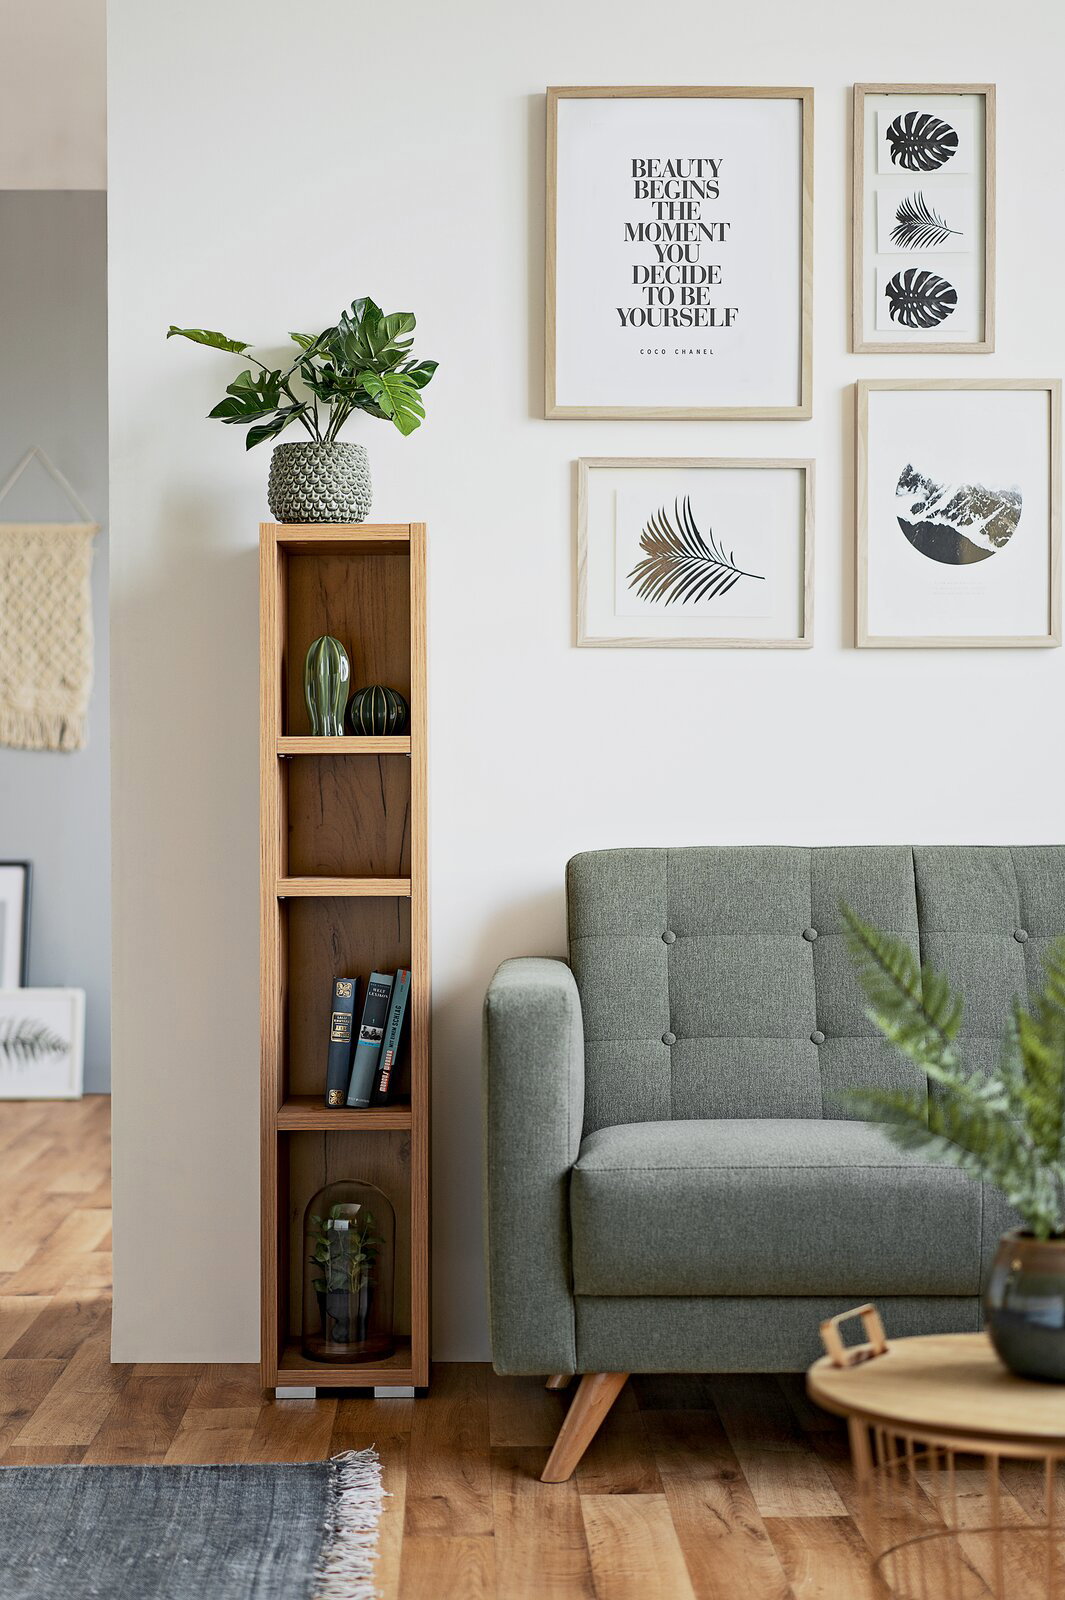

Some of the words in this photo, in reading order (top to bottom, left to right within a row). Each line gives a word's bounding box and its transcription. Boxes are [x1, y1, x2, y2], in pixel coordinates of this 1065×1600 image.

[631, 158, 723, 179] BEAUTY
[634, 179, 720, 200] BEGINS
[651, 201, 702, 221] THE
[623, 222, 731, 243] MOMENT
[653, 243, 701, 264] YOU
[631, 264, 722, 285] DECIDE
[642, 286, 675, 306] TO
[680, 286, 711, 306] BE
[615, 307, 739, 328] YOURSELF
[392, 1005, 402, 1026] SCHLAG
